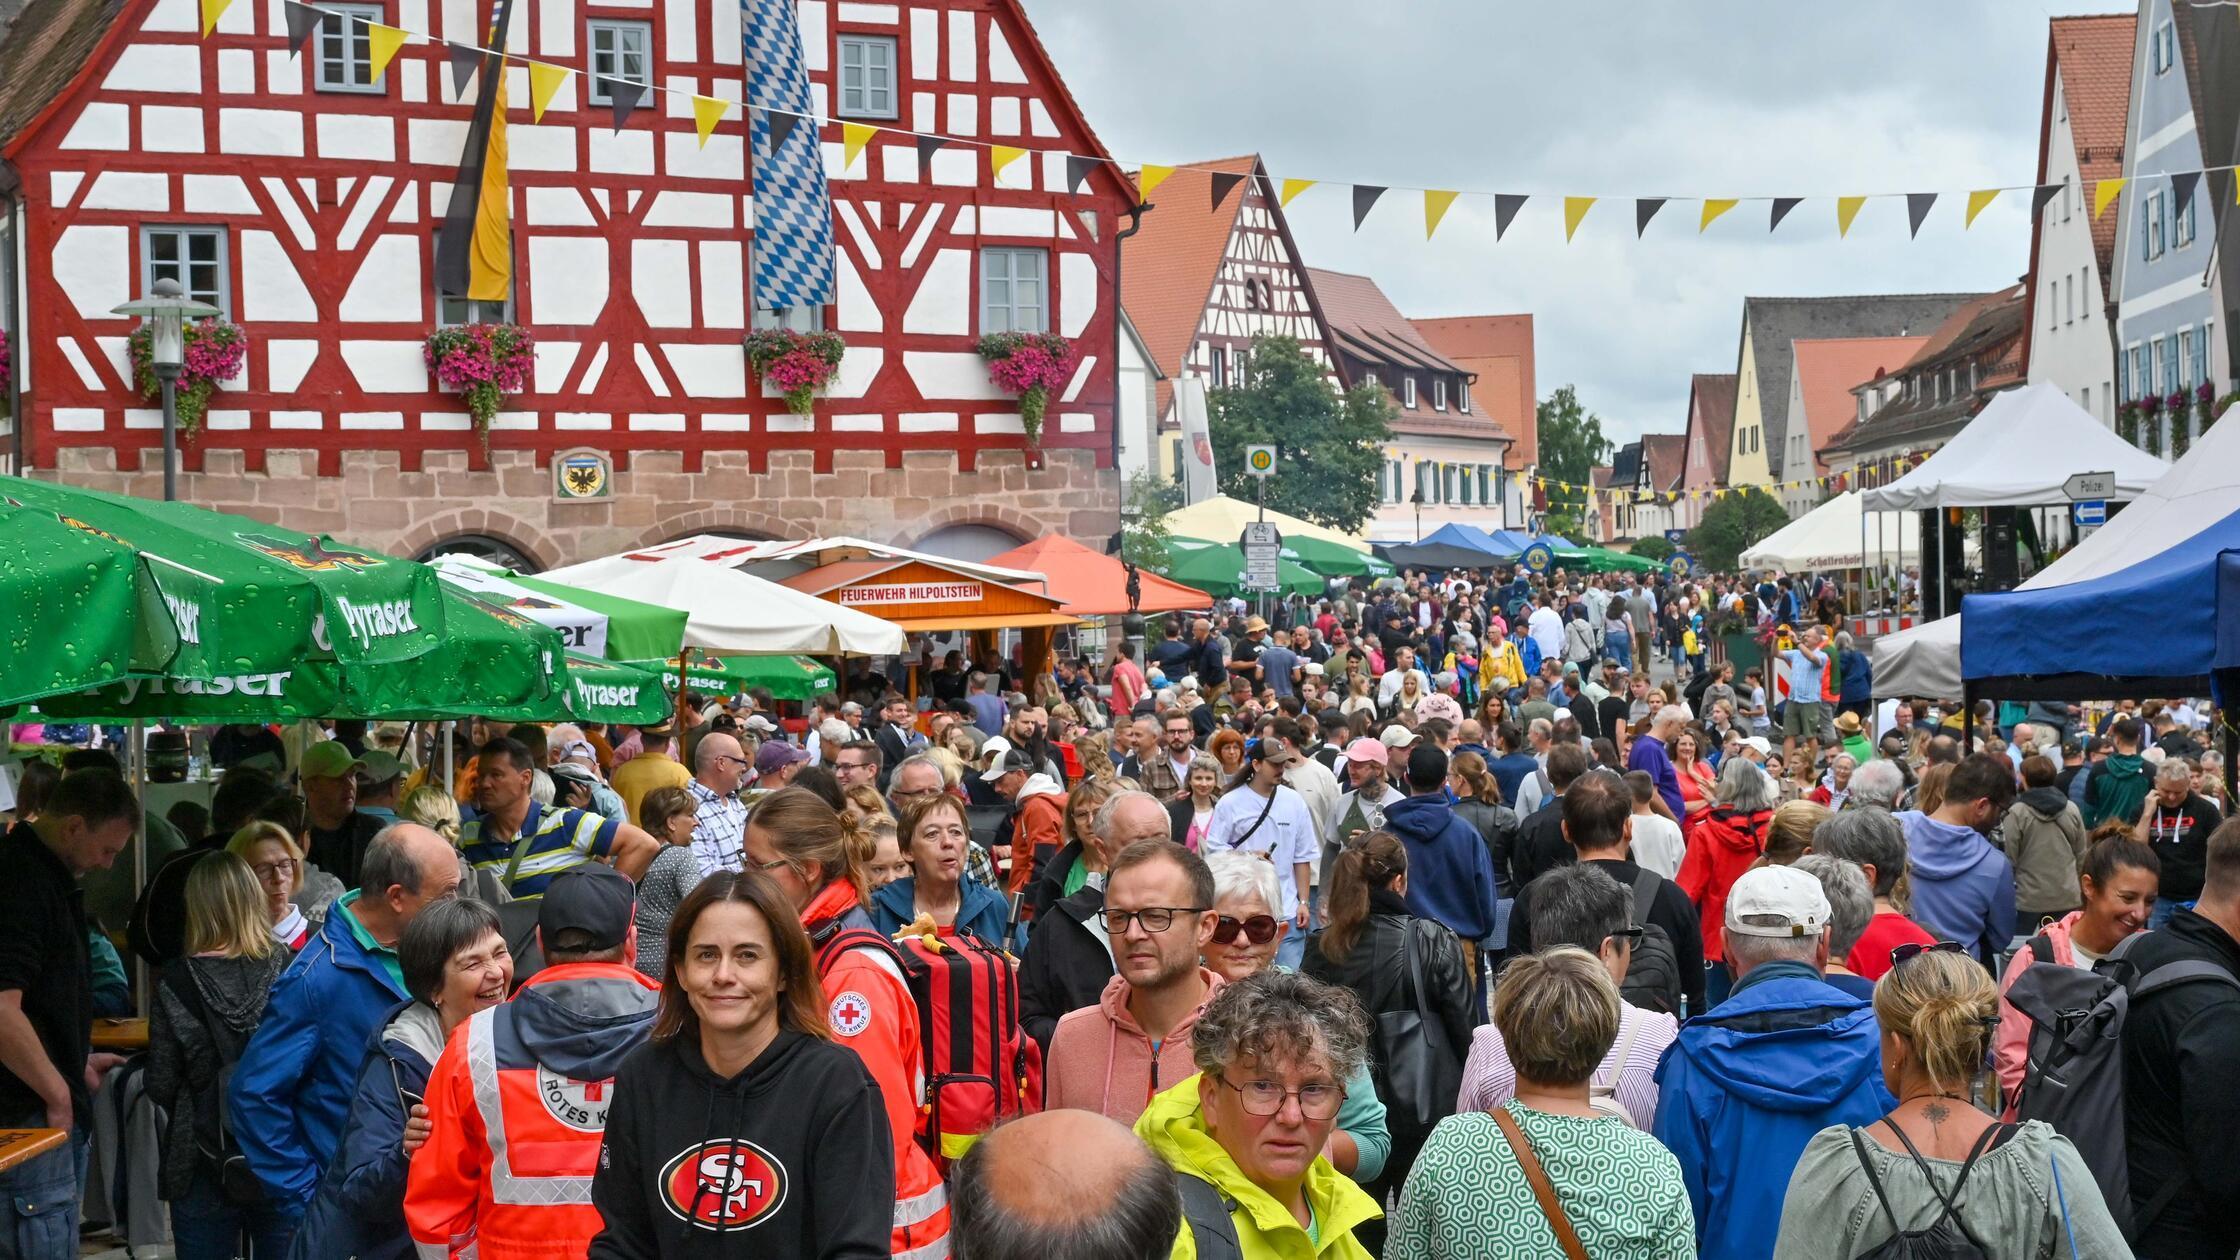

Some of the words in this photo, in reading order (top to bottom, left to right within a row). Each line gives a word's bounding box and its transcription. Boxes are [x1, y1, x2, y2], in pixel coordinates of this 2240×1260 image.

[1256, 454, 1266, 467] H
[841, 587, 906, 601] FEUERWEHR
[909, 585, 981, 599] HILPOLTSTEIN
[336, 596, 419, 650] Pyraser
[575, 677, 640, 711] Pyraser
[834, 994, 867, 1010] DEUTSCHES
[848, 1015, 867, 1033] KREUZ
[545, 1079, 589, 1124] ROTES
[699, 1153, 763, 1218] SF
